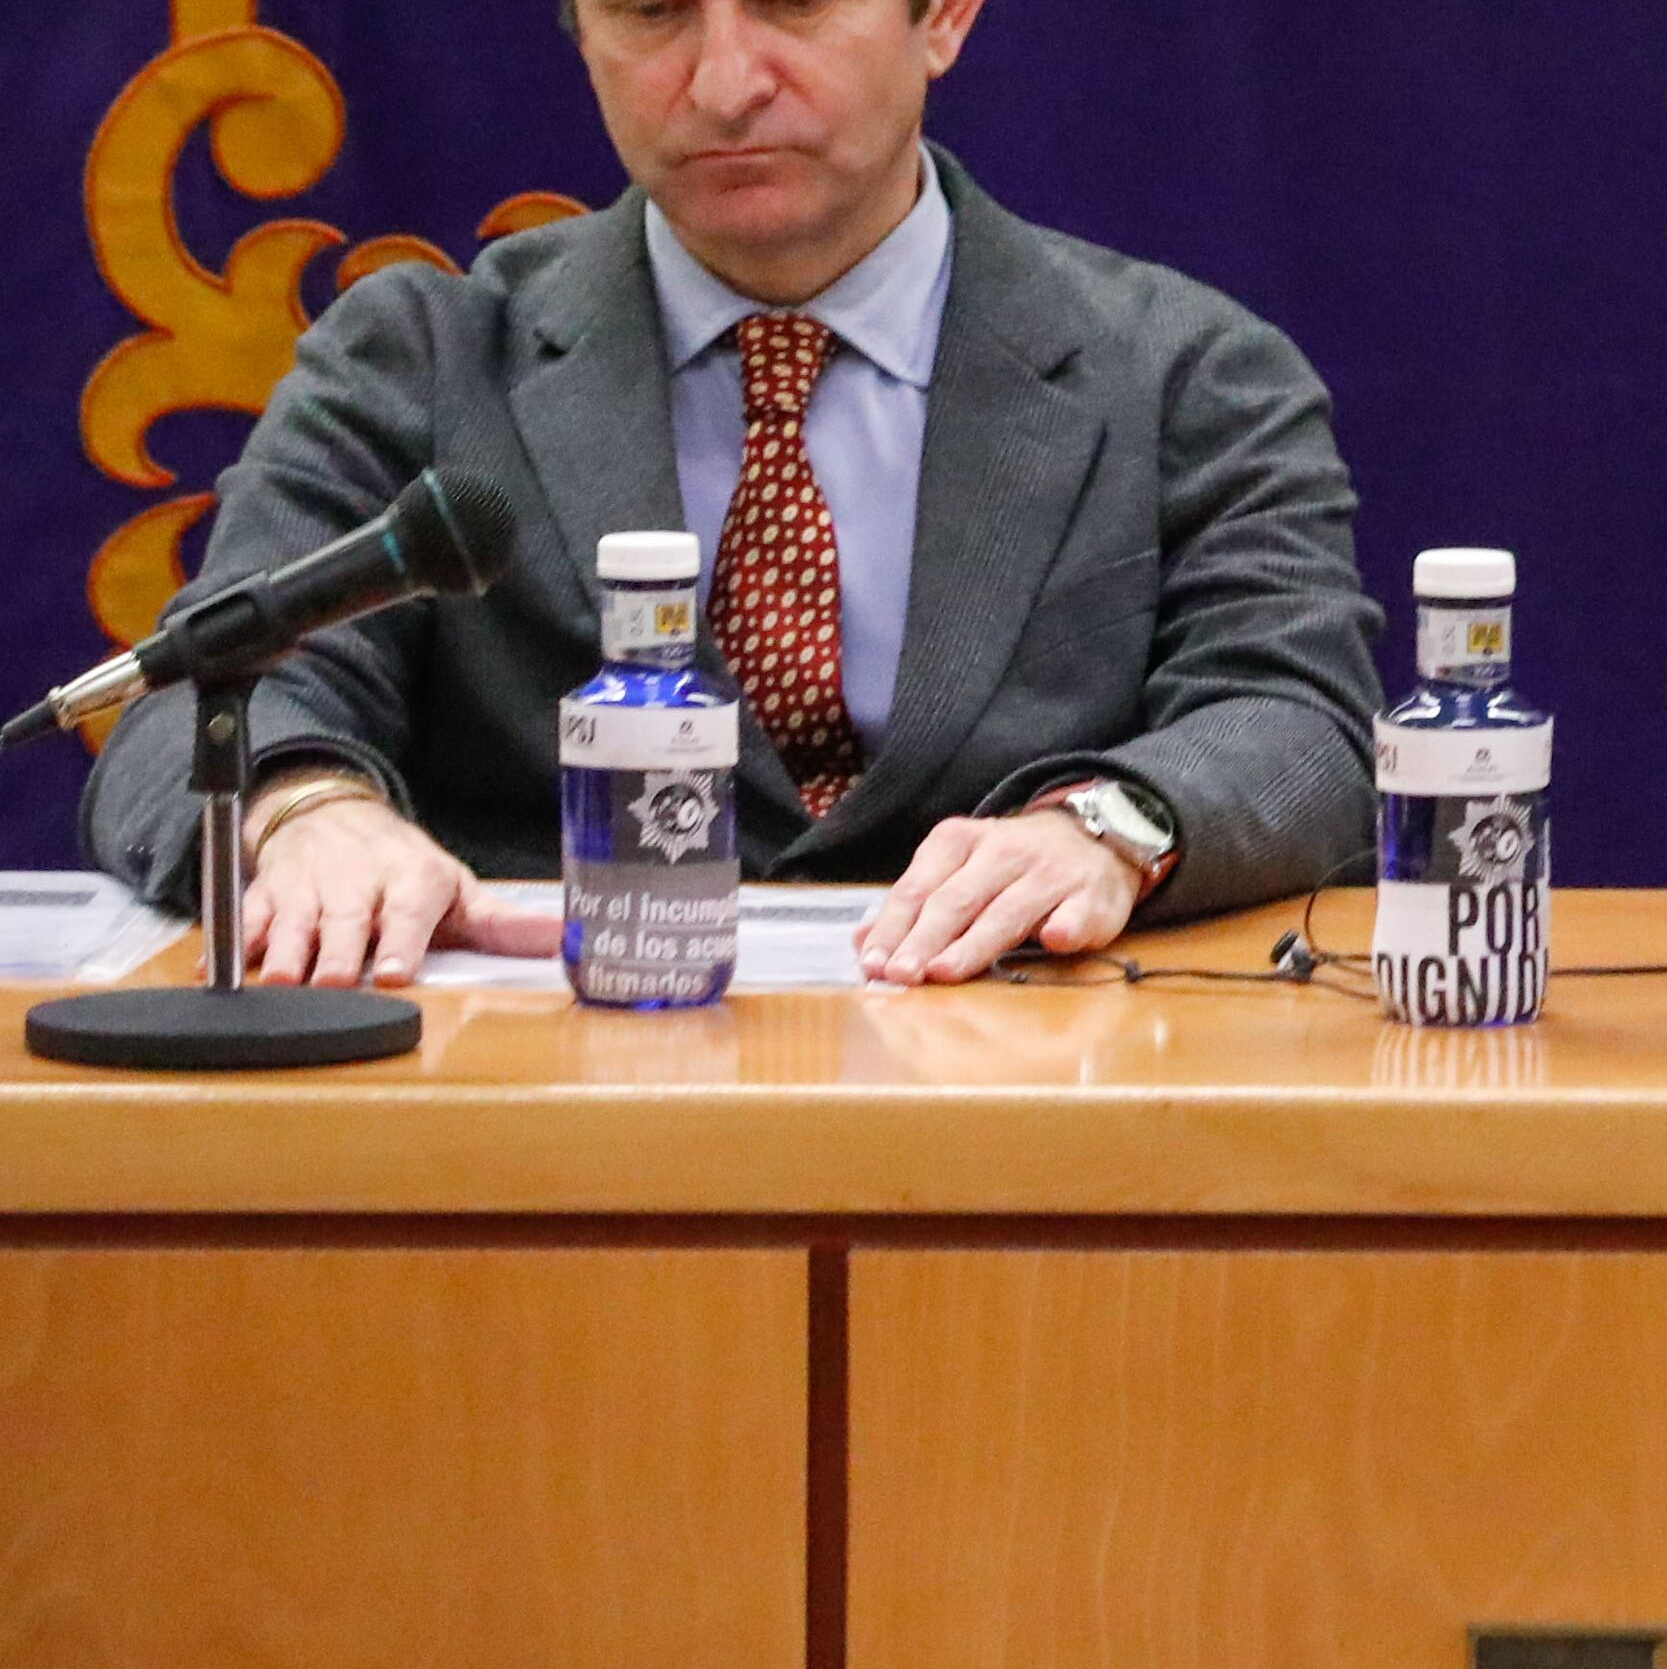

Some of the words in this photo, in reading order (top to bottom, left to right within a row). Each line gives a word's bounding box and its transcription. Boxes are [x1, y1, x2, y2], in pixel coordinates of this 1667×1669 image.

[569, 885, 604, 917] Por
[607, 891, 632, 921] el
[1449, 884, 1539, 956] POR
[593, 928, 627, 958] de
[635, 930, 679, 961] los
[587, 963, 705, 995] firmados
